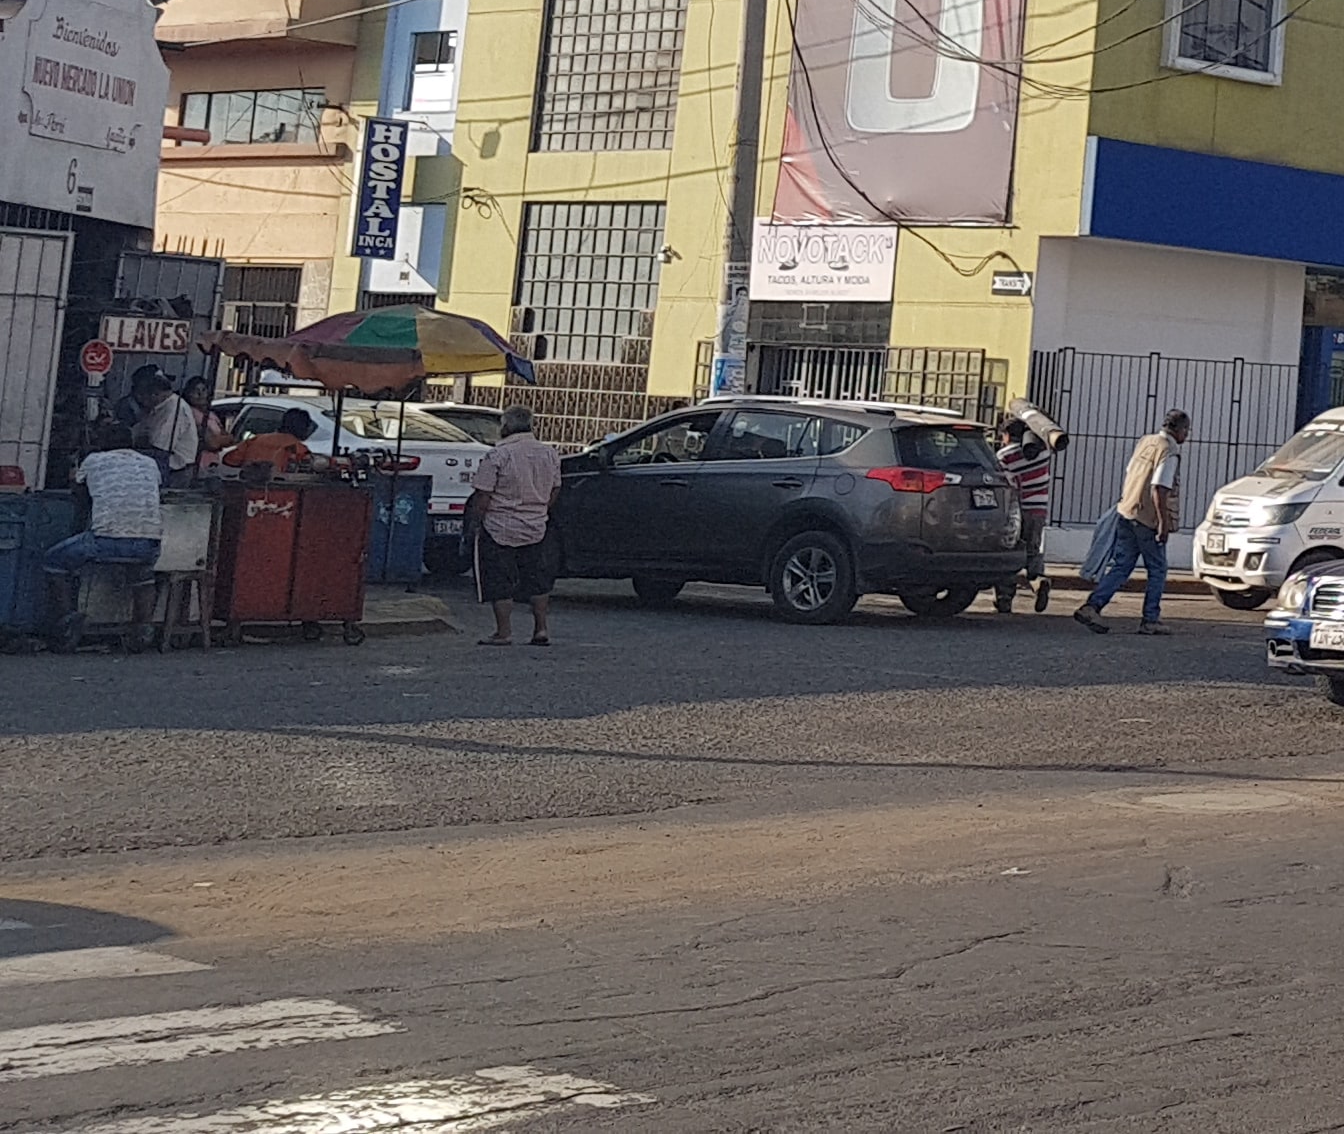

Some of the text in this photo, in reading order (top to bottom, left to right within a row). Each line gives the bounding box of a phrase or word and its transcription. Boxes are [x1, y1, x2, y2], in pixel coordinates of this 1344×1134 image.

[66, 158, 78, 194] 6
[362, 123, 404, 237] HOSTAL
[358, 235, 394, 248] INCA
[800, 275, 834, 285] ALTURA
[103, 318, 189, 351] LLAVES
